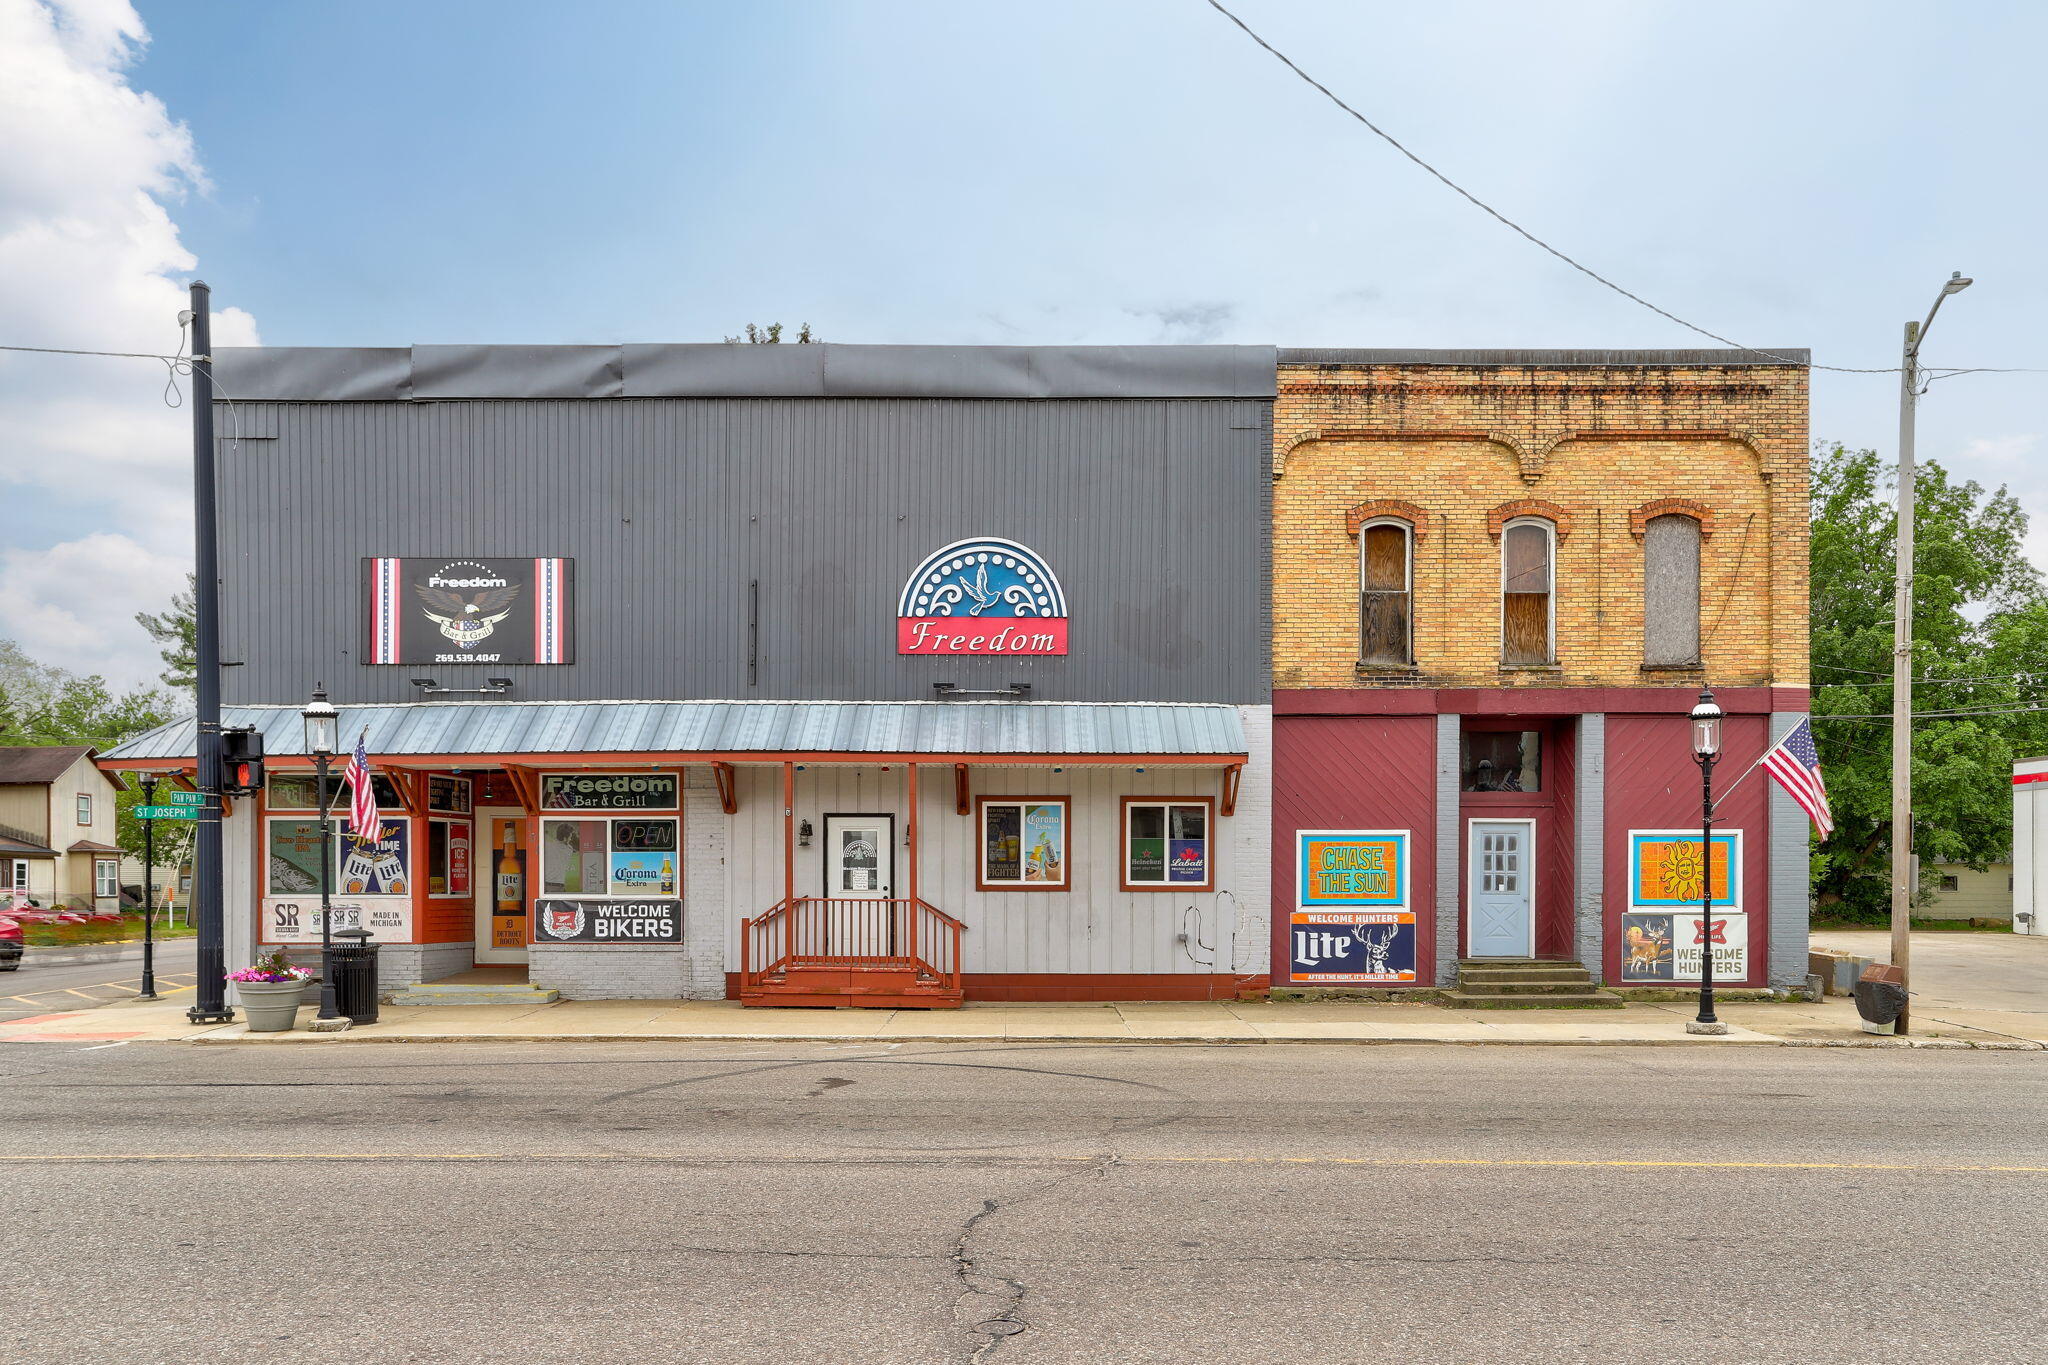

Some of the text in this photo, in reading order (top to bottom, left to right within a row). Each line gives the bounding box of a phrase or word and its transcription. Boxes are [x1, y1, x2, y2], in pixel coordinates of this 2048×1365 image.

[429, 577, 507, 588] Freedom
[443, 627, 459, 638] Bar
[470, 627, 491, 639] Grill
[909, 622, 1055, 651] Freedom
[435, 654, 500, 662] 269.539.4047
[547, 777, 673, 793] Freedom
[174, 794, 184, 802] PAW
[186, 795, 196, 803] PAW
[575, 794, 646, 806] Bar & Grill
[137, 808, 148, 817] ST
[153, 808, 186, 817] JOSEPH
[1027, 814, 1059, 825] Corona
[618, 826, 671, 846] OPEN
[455, 849, 465, 859] ICE
[1322, 847, 1383, 870] CHASE
[349, 860, 373, 876] Lite
[1171, 858, 1204, 866] Labatt
[379, 862, 402, 880] Lite
[615, 868, 657, 880] Corona
[502, 875, 518, 885] Lite
[1318, 873, 1387, 892] THE SUN
[275, 904, 298, 926] SR
[334, 911, 344, 921] SR
[348, 911, 359, 922] SR
[598, 905, 671, 917] WELCOME
[1308, 914, 1398, 922] WELCOME HUNTERS
[595, 919, 673, 937] BIKERS
[1294, 931, 1351, 966] Lite
[1677, 949, 1743, 959] WELOME
